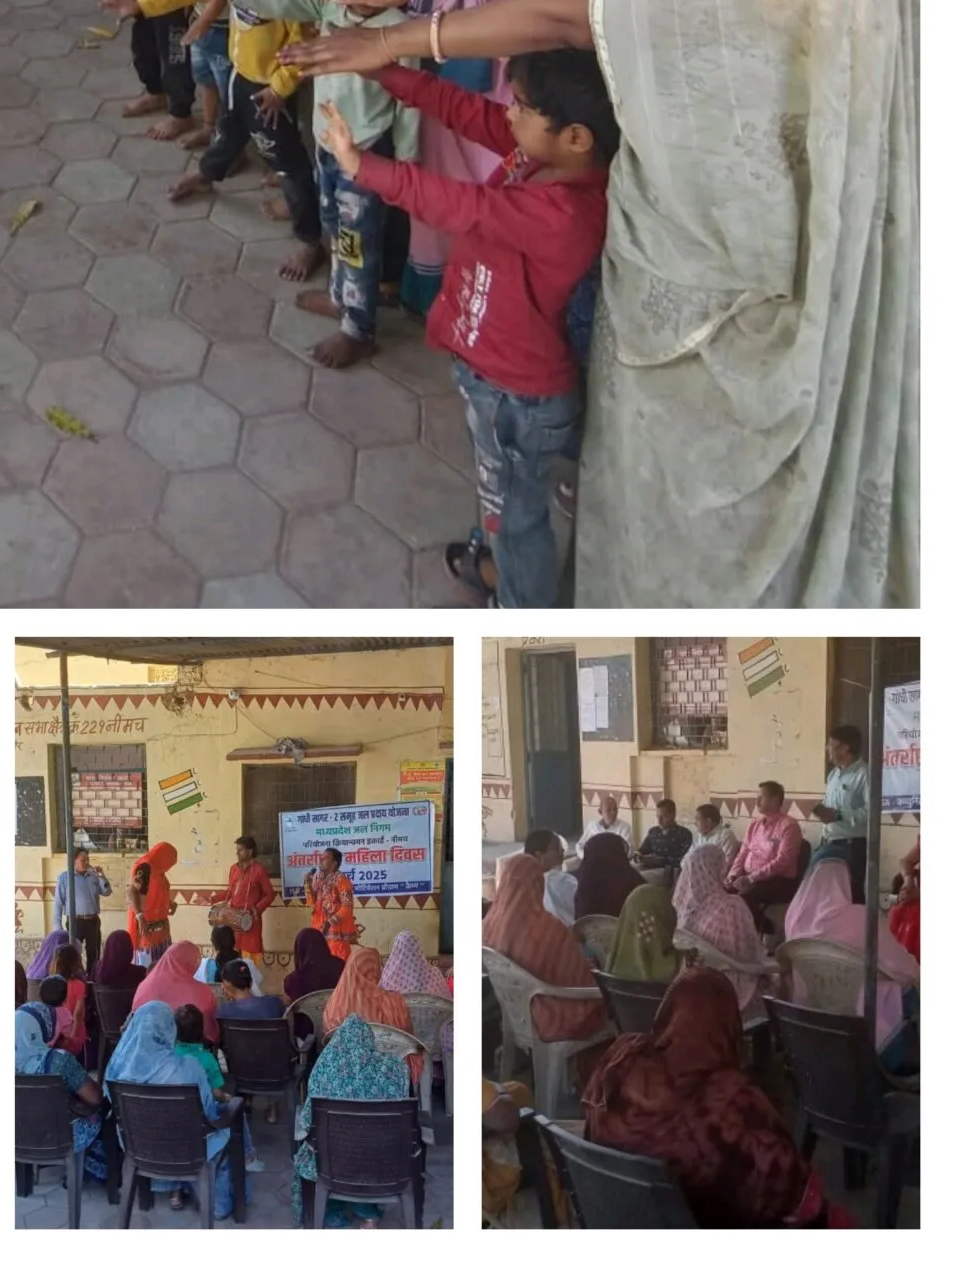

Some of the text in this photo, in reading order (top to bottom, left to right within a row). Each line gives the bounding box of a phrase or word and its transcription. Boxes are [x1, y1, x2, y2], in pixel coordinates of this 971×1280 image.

[105, 713, 150, 733] नीमच
[316, 822, 391, 836] मध्यप्रदेश जल निगम
[344, 848, 387, 864] महिला
[390, 845, 427, 862] दिवस
[359, 870, 388, 881] 2025
